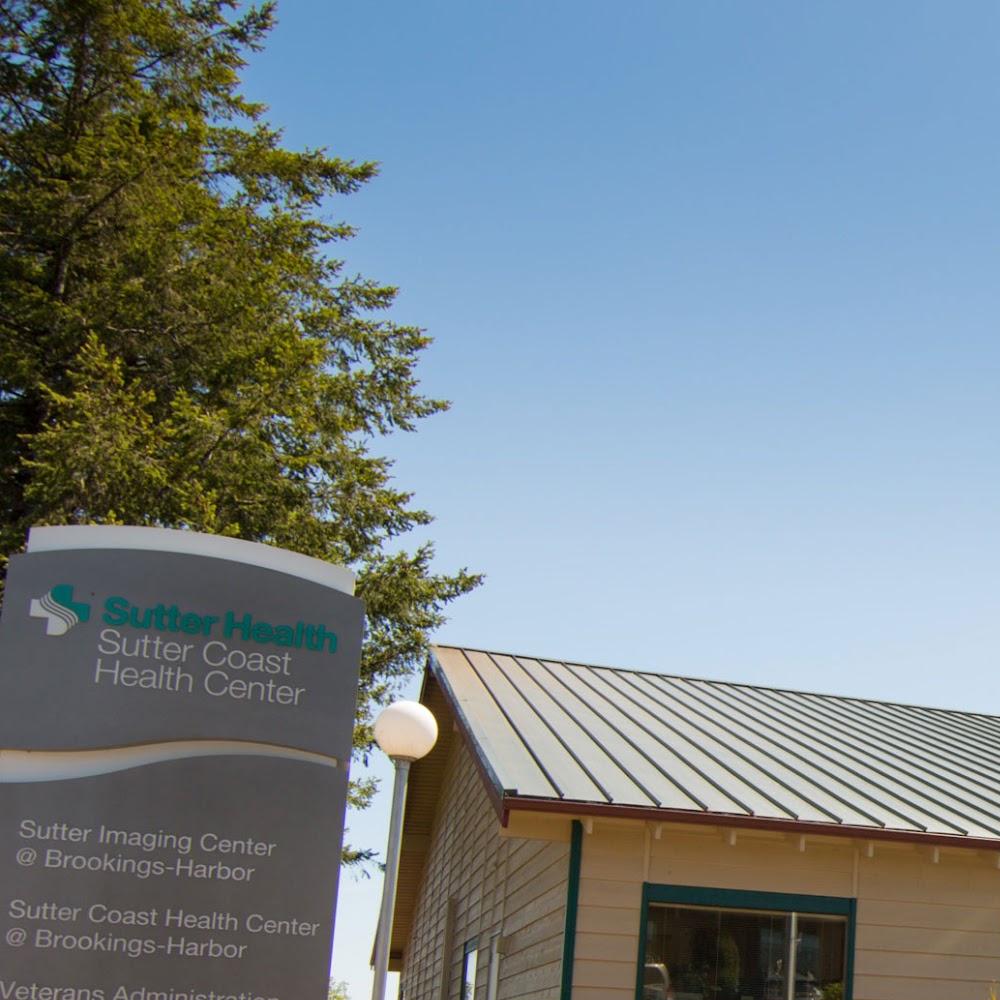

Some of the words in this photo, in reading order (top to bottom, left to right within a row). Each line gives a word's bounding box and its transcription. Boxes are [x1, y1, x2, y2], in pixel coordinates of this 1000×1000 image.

[102, 596, 219, 636] Sutter
[223, 610, 338, 653] Health
[98, 629, 195, 662] Sutter
[202, 640, 292, 676] Coast
[94, 659, 193, 693] Health
[203, 671, 305, 706] Center
[19, 820, 92, 842] Sutter
[99, 825, 192, 852] Imaging
[200, 833, 277, 857] Center
[16, 848, 37, 867] @
[44, 849, 256, 881] Brookings-Harbor
[8, 900, 82, 922] Sutter
[88, 904, 158, 927] Coast
[164, 909, 239, 932] Health
[245, 914, 320, 937] Center
[5, 928, 27, 947] @
[34, 929, 248, 958] Brookings-Harbor
